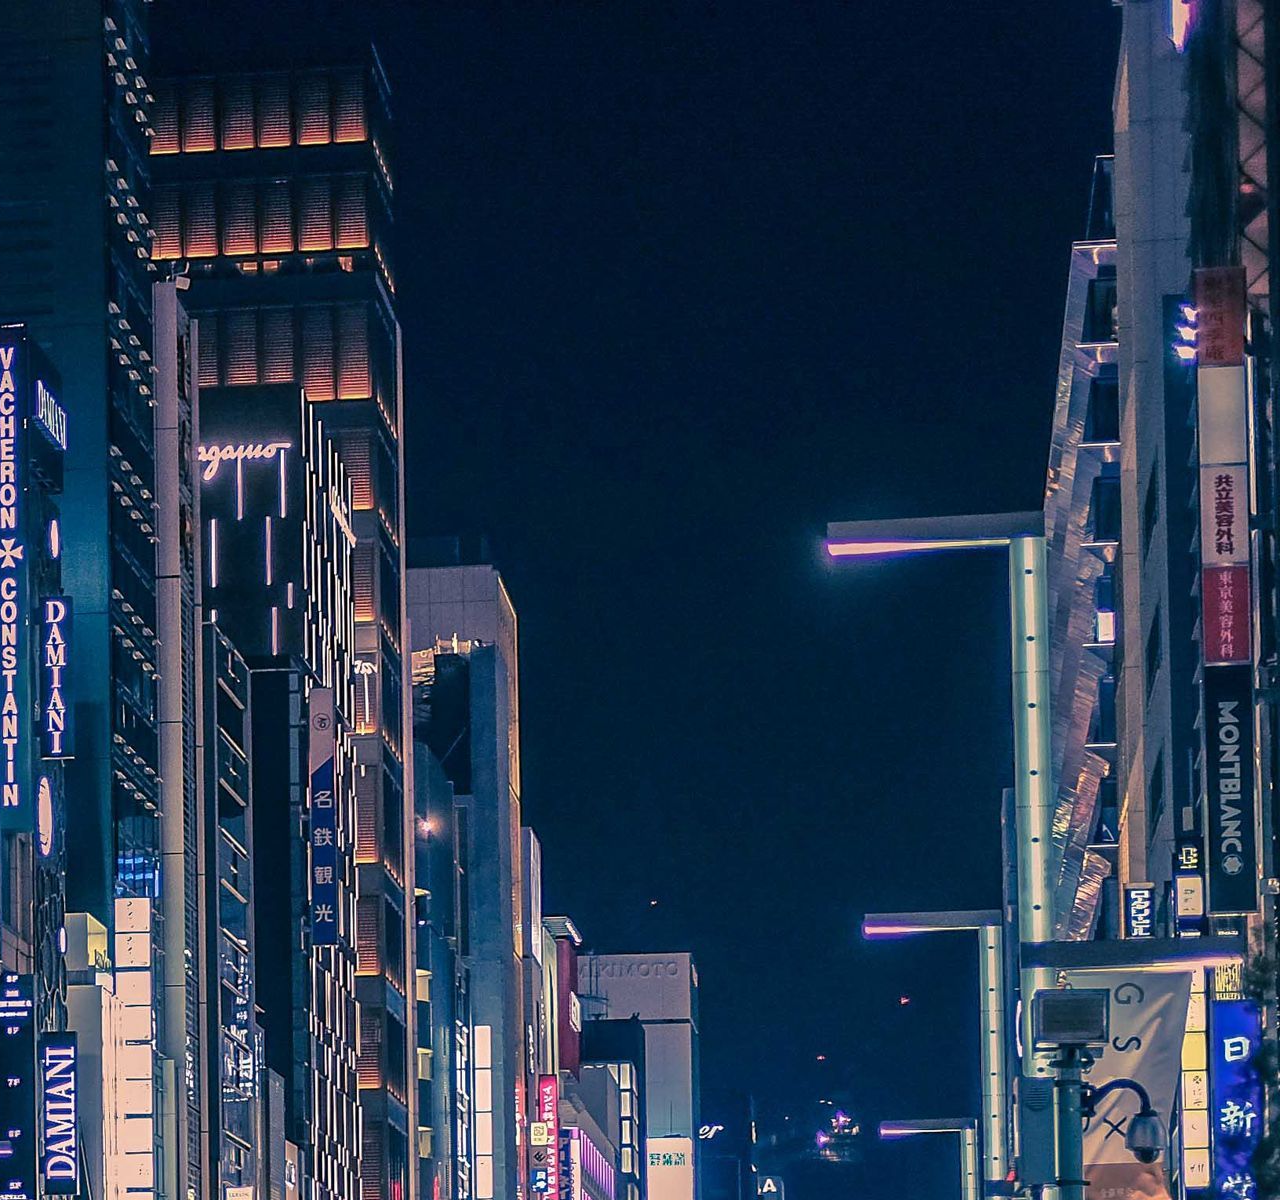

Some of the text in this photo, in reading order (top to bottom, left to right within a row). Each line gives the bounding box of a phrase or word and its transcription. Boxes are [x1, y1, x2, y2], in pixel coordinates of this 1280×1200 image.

[0, 348, 19, 807] VACHERON CONSTANTIN
[1214, 474, 1234, 556] 共立美容外科
[46, 601, 67, 754] DAMIANI
[1217, 570, 1235, 658] 東京美容外科
[1217, 701, 1242, 853] MONTBLANC
[314, 790, 334, 922] 名鉄観光
[46, 1046, 76, 1180] DAMIANI
